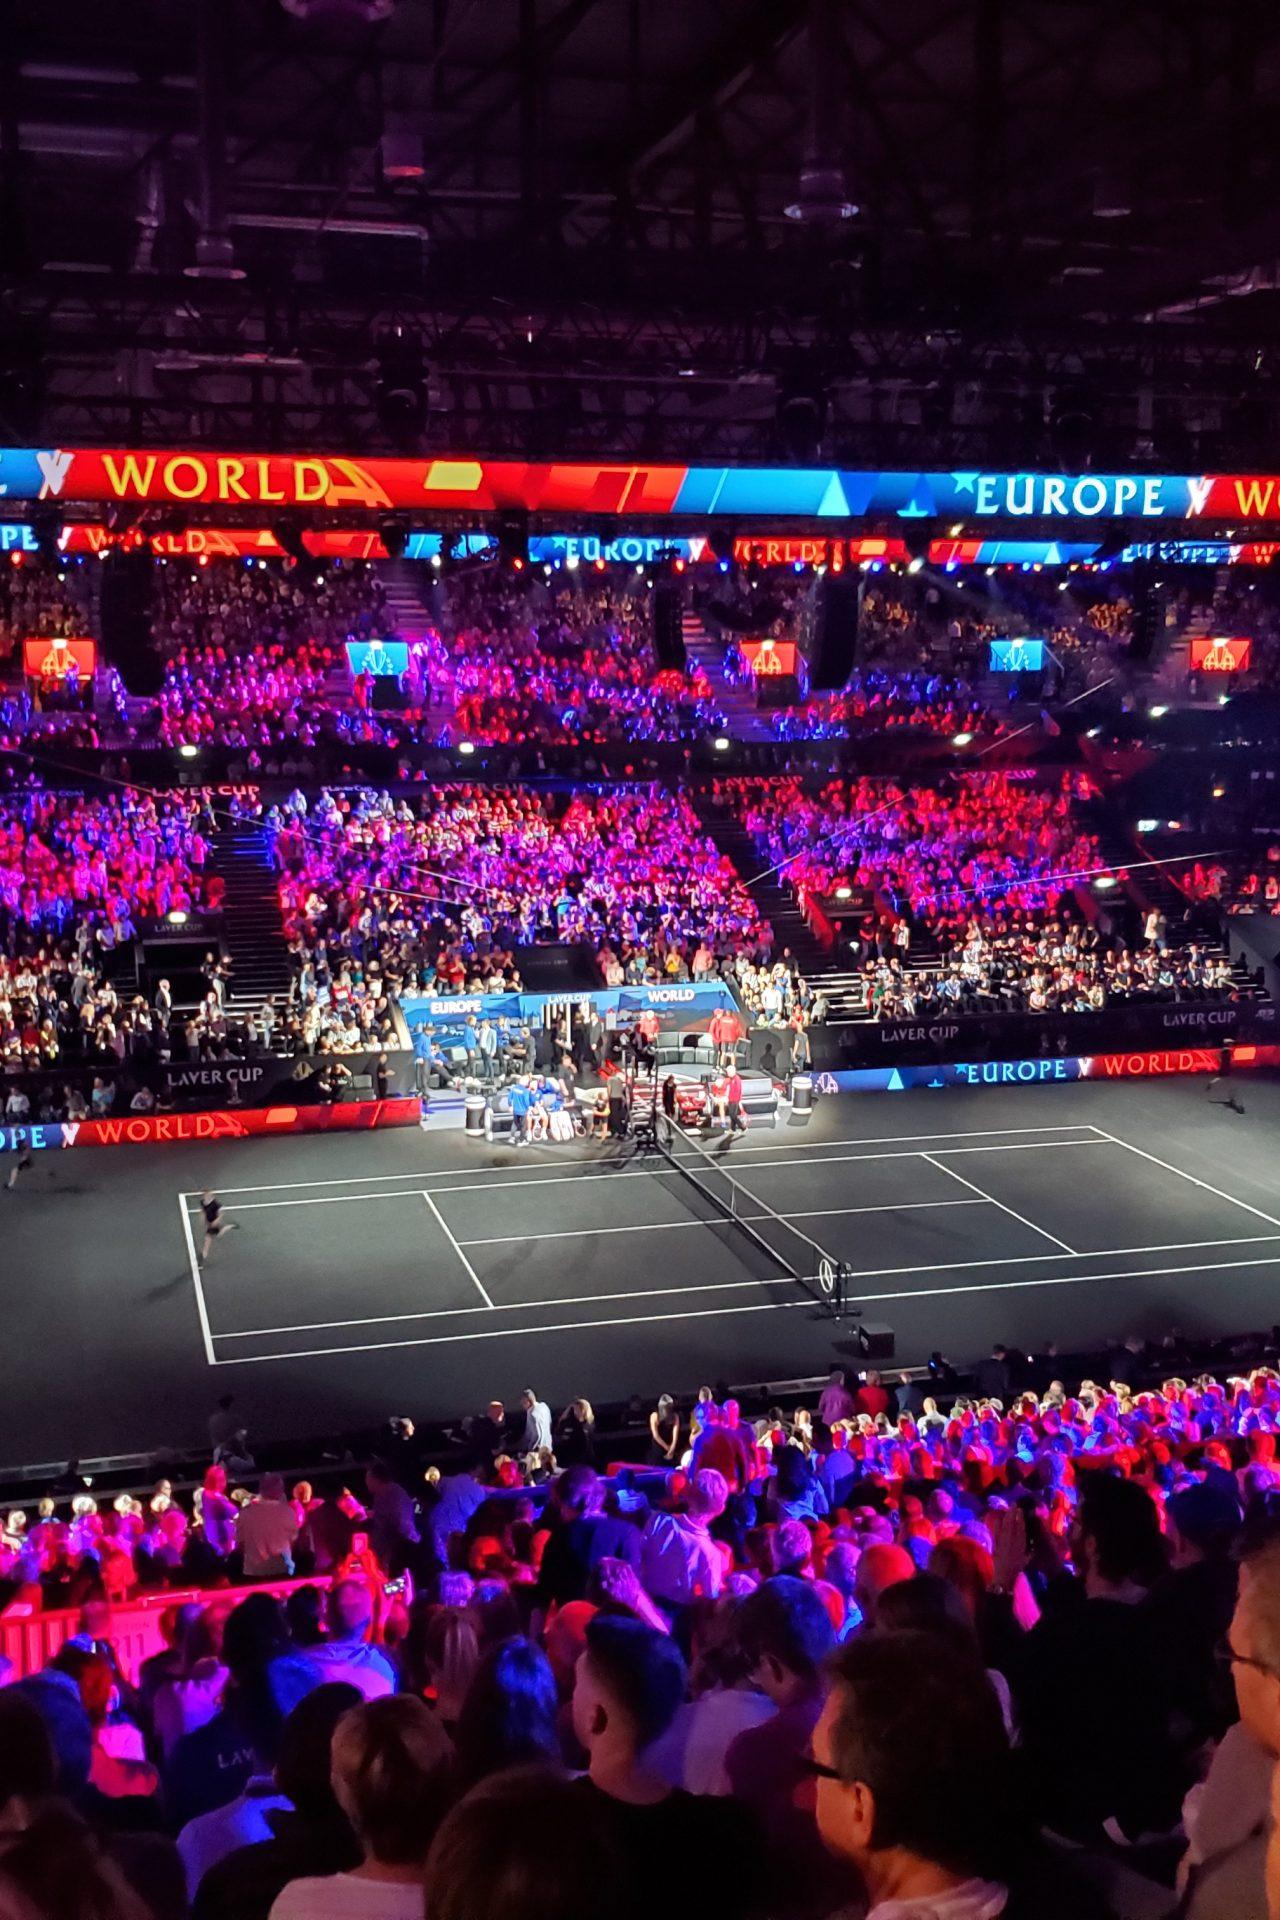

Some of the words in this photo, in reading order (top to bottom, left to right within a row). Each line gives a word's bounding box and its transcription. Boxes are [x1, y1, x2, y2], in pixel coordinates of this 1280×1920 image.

[101, 454, 330, 501] WORLD
[975, 476, 1165, 516] EUROPE
[218, 784, 260, 796] CUP
[648, 989, 695, 1002] WORLD
[430, 1000, 482, 1015] EUROPE
[1163, 1012, 1206, 1027] LAVER
[1208, 1010, 1237, 1024] CUP
[881, 1027, 926, 1042] LAVER
[928, 1026, 960, 1041] CUP
[167, 1069, 224, 1087] LAVER
[226, 1067, 264, 1083] CUP
[967, 1059, 1066, 1084] EUROPE
[1104, 1052, 1194, 1076] WORLD
[95, 1115, 216, 1145] WORLD
